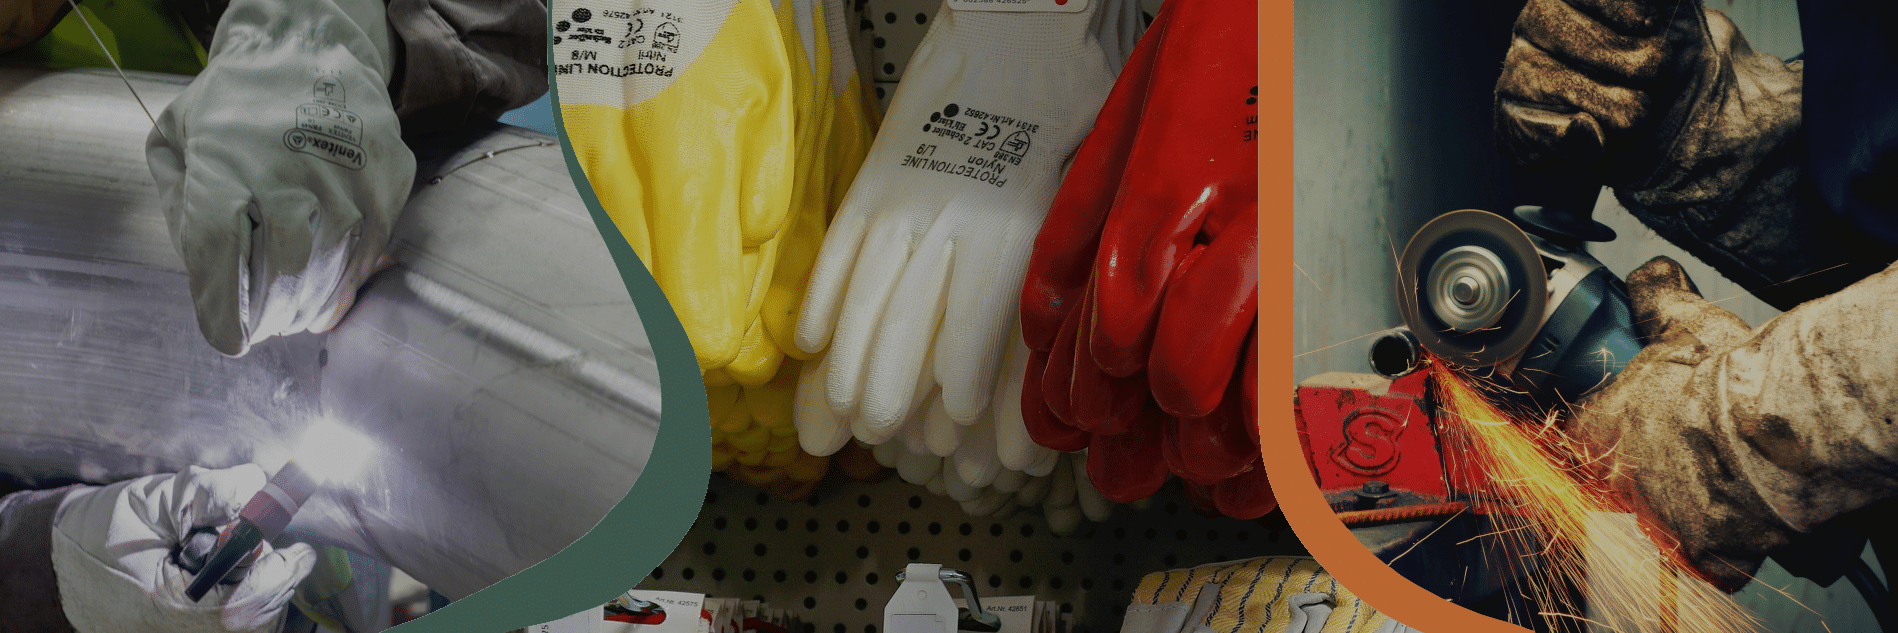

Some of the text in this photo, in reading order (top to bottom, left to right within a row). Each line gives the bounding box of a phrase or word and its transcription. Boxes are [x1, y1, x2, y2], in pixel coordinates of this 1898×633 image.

[571, 50, 666, 62] Nitril M/8
[588, 63, 673, 78] PROTECTION
[963, 135, 996, 151] CAT 2
[916, 143, 1006, 175] Nylon L/9
[901, 154, 1008, 188] PROTECTION LINE
